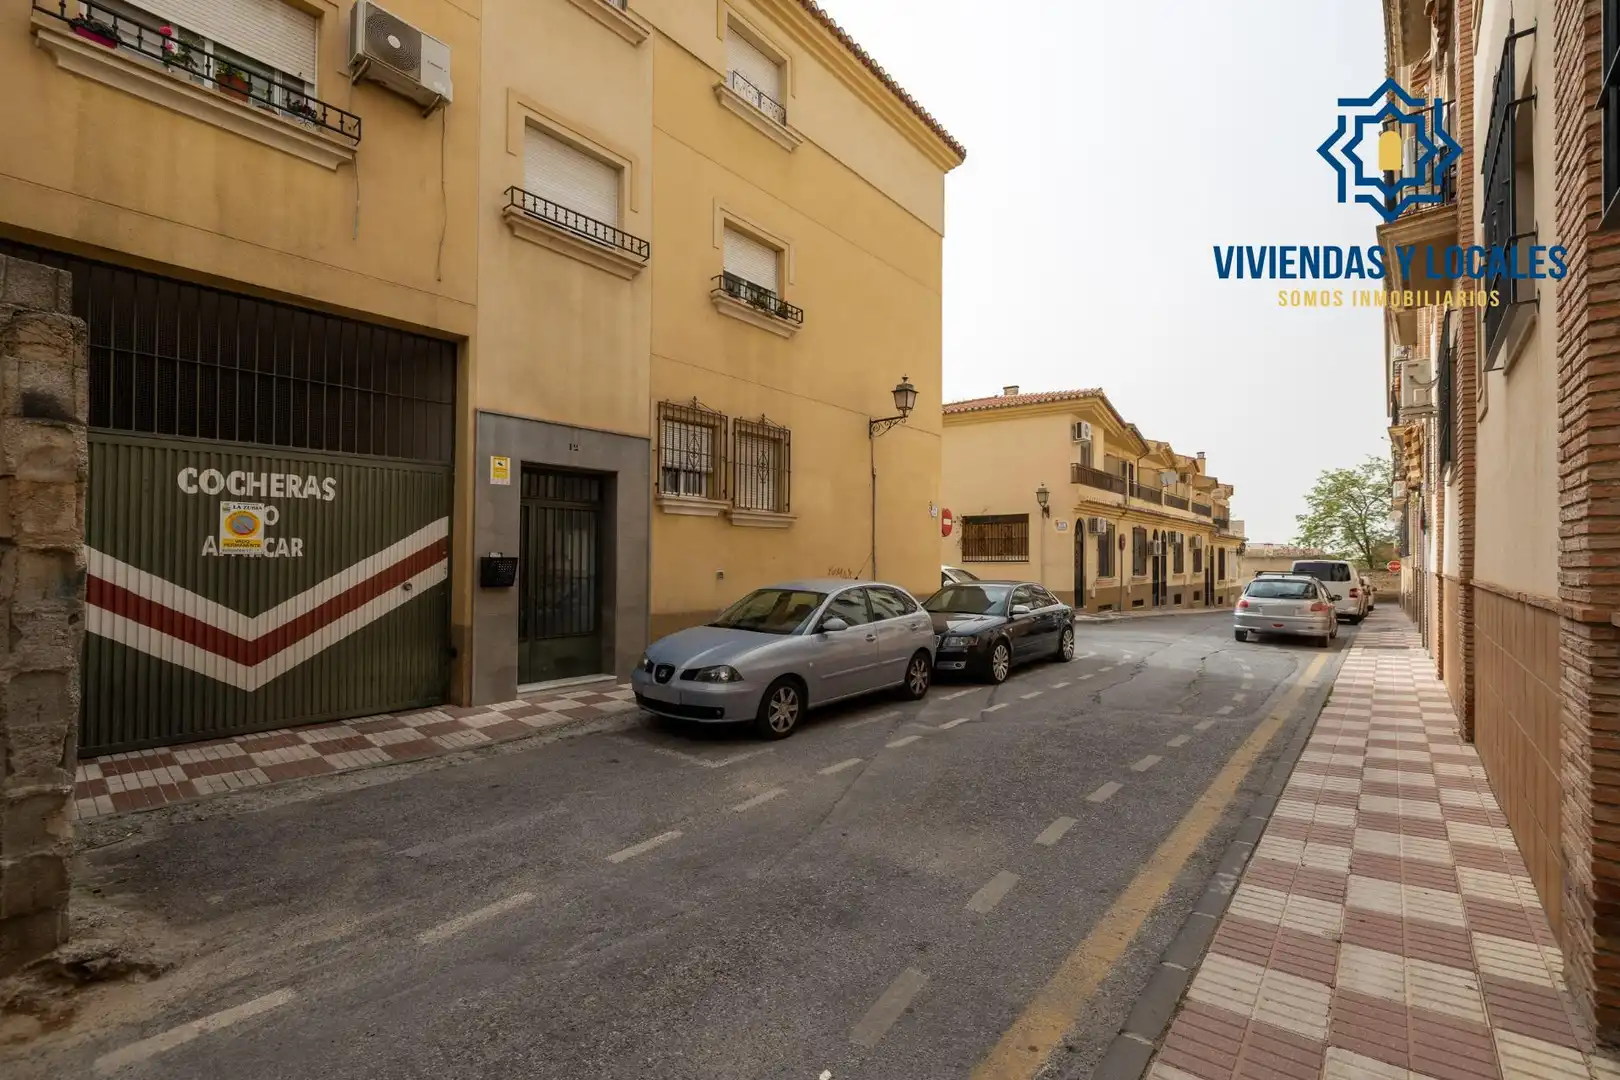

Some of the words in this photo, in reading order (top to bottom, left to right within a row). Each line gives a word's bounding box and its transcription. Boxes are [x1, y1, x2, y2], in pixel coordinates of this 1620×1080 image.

[177, 467, 337, 501] COCHERAS
[263, 505, 280, 526] O
[201, 535, 303, 558] ACAR
